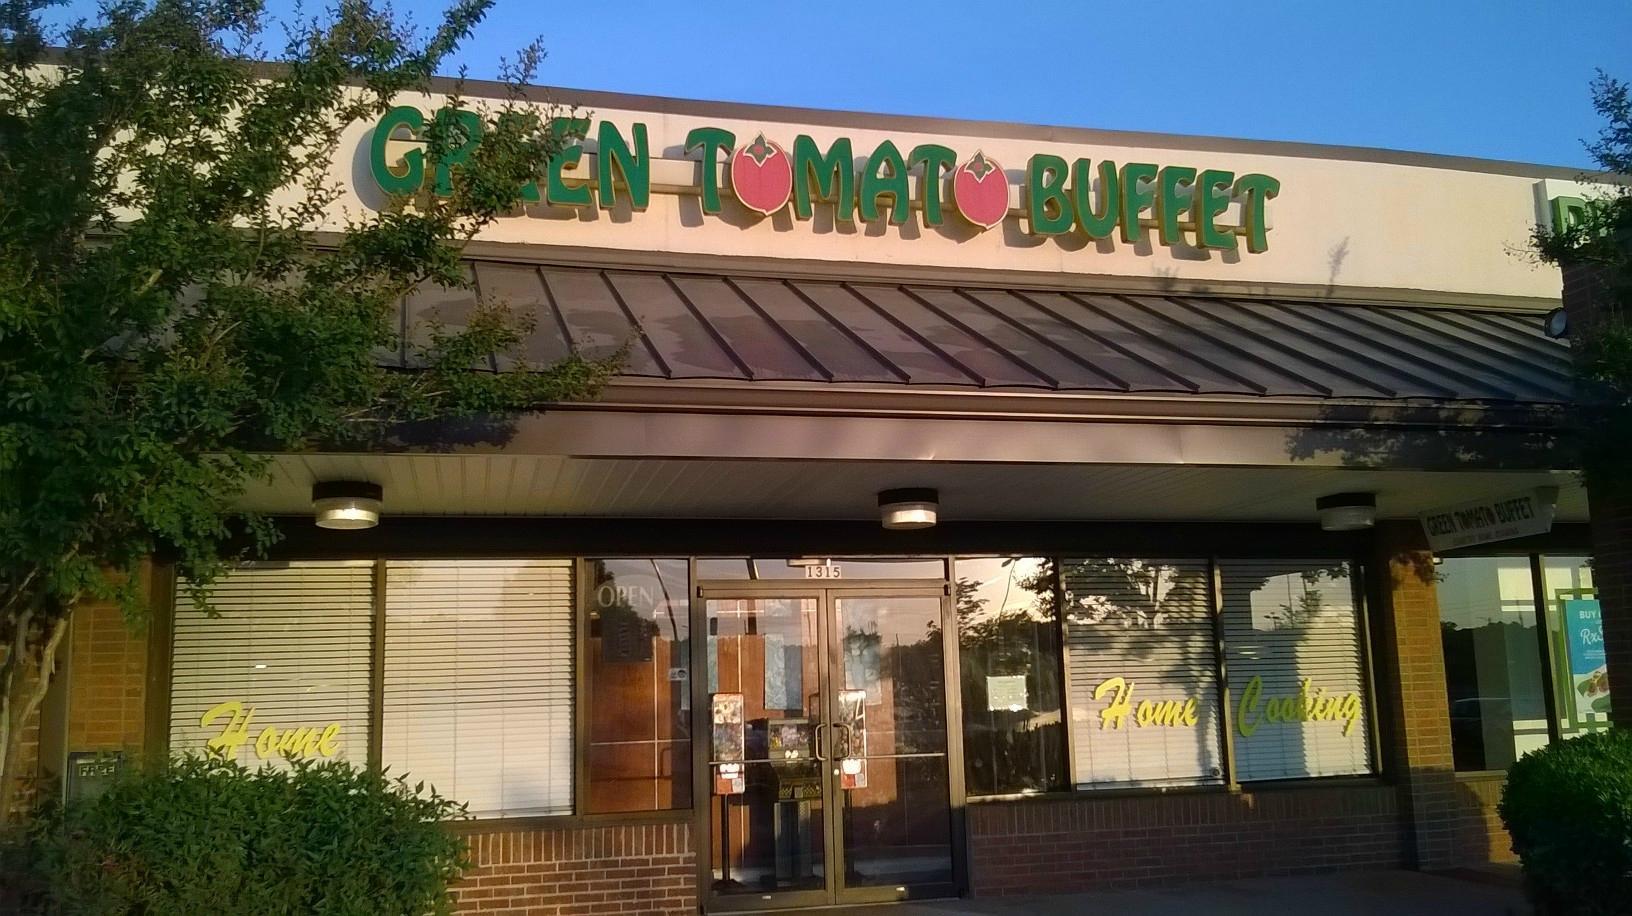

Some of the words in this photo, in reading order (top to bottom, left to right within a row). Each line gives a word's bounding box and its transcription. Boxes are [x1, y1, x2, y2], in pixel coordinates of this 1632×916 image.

[1027, 153, 1281, 254] BUFFET
[1427, 512, 1458, 536] GREEN
[1494, 496, 1535, 523] BUFFET
[807, 566, 841, 578] 1315
[597, 585, 655, 608] OPEN
[1579, 610, 1596, 619] BUY
[1094, 676, 1200, 732] Home
[1236, 674, 1361, 738] Cooking
[201, 701, 342, 761] Home
